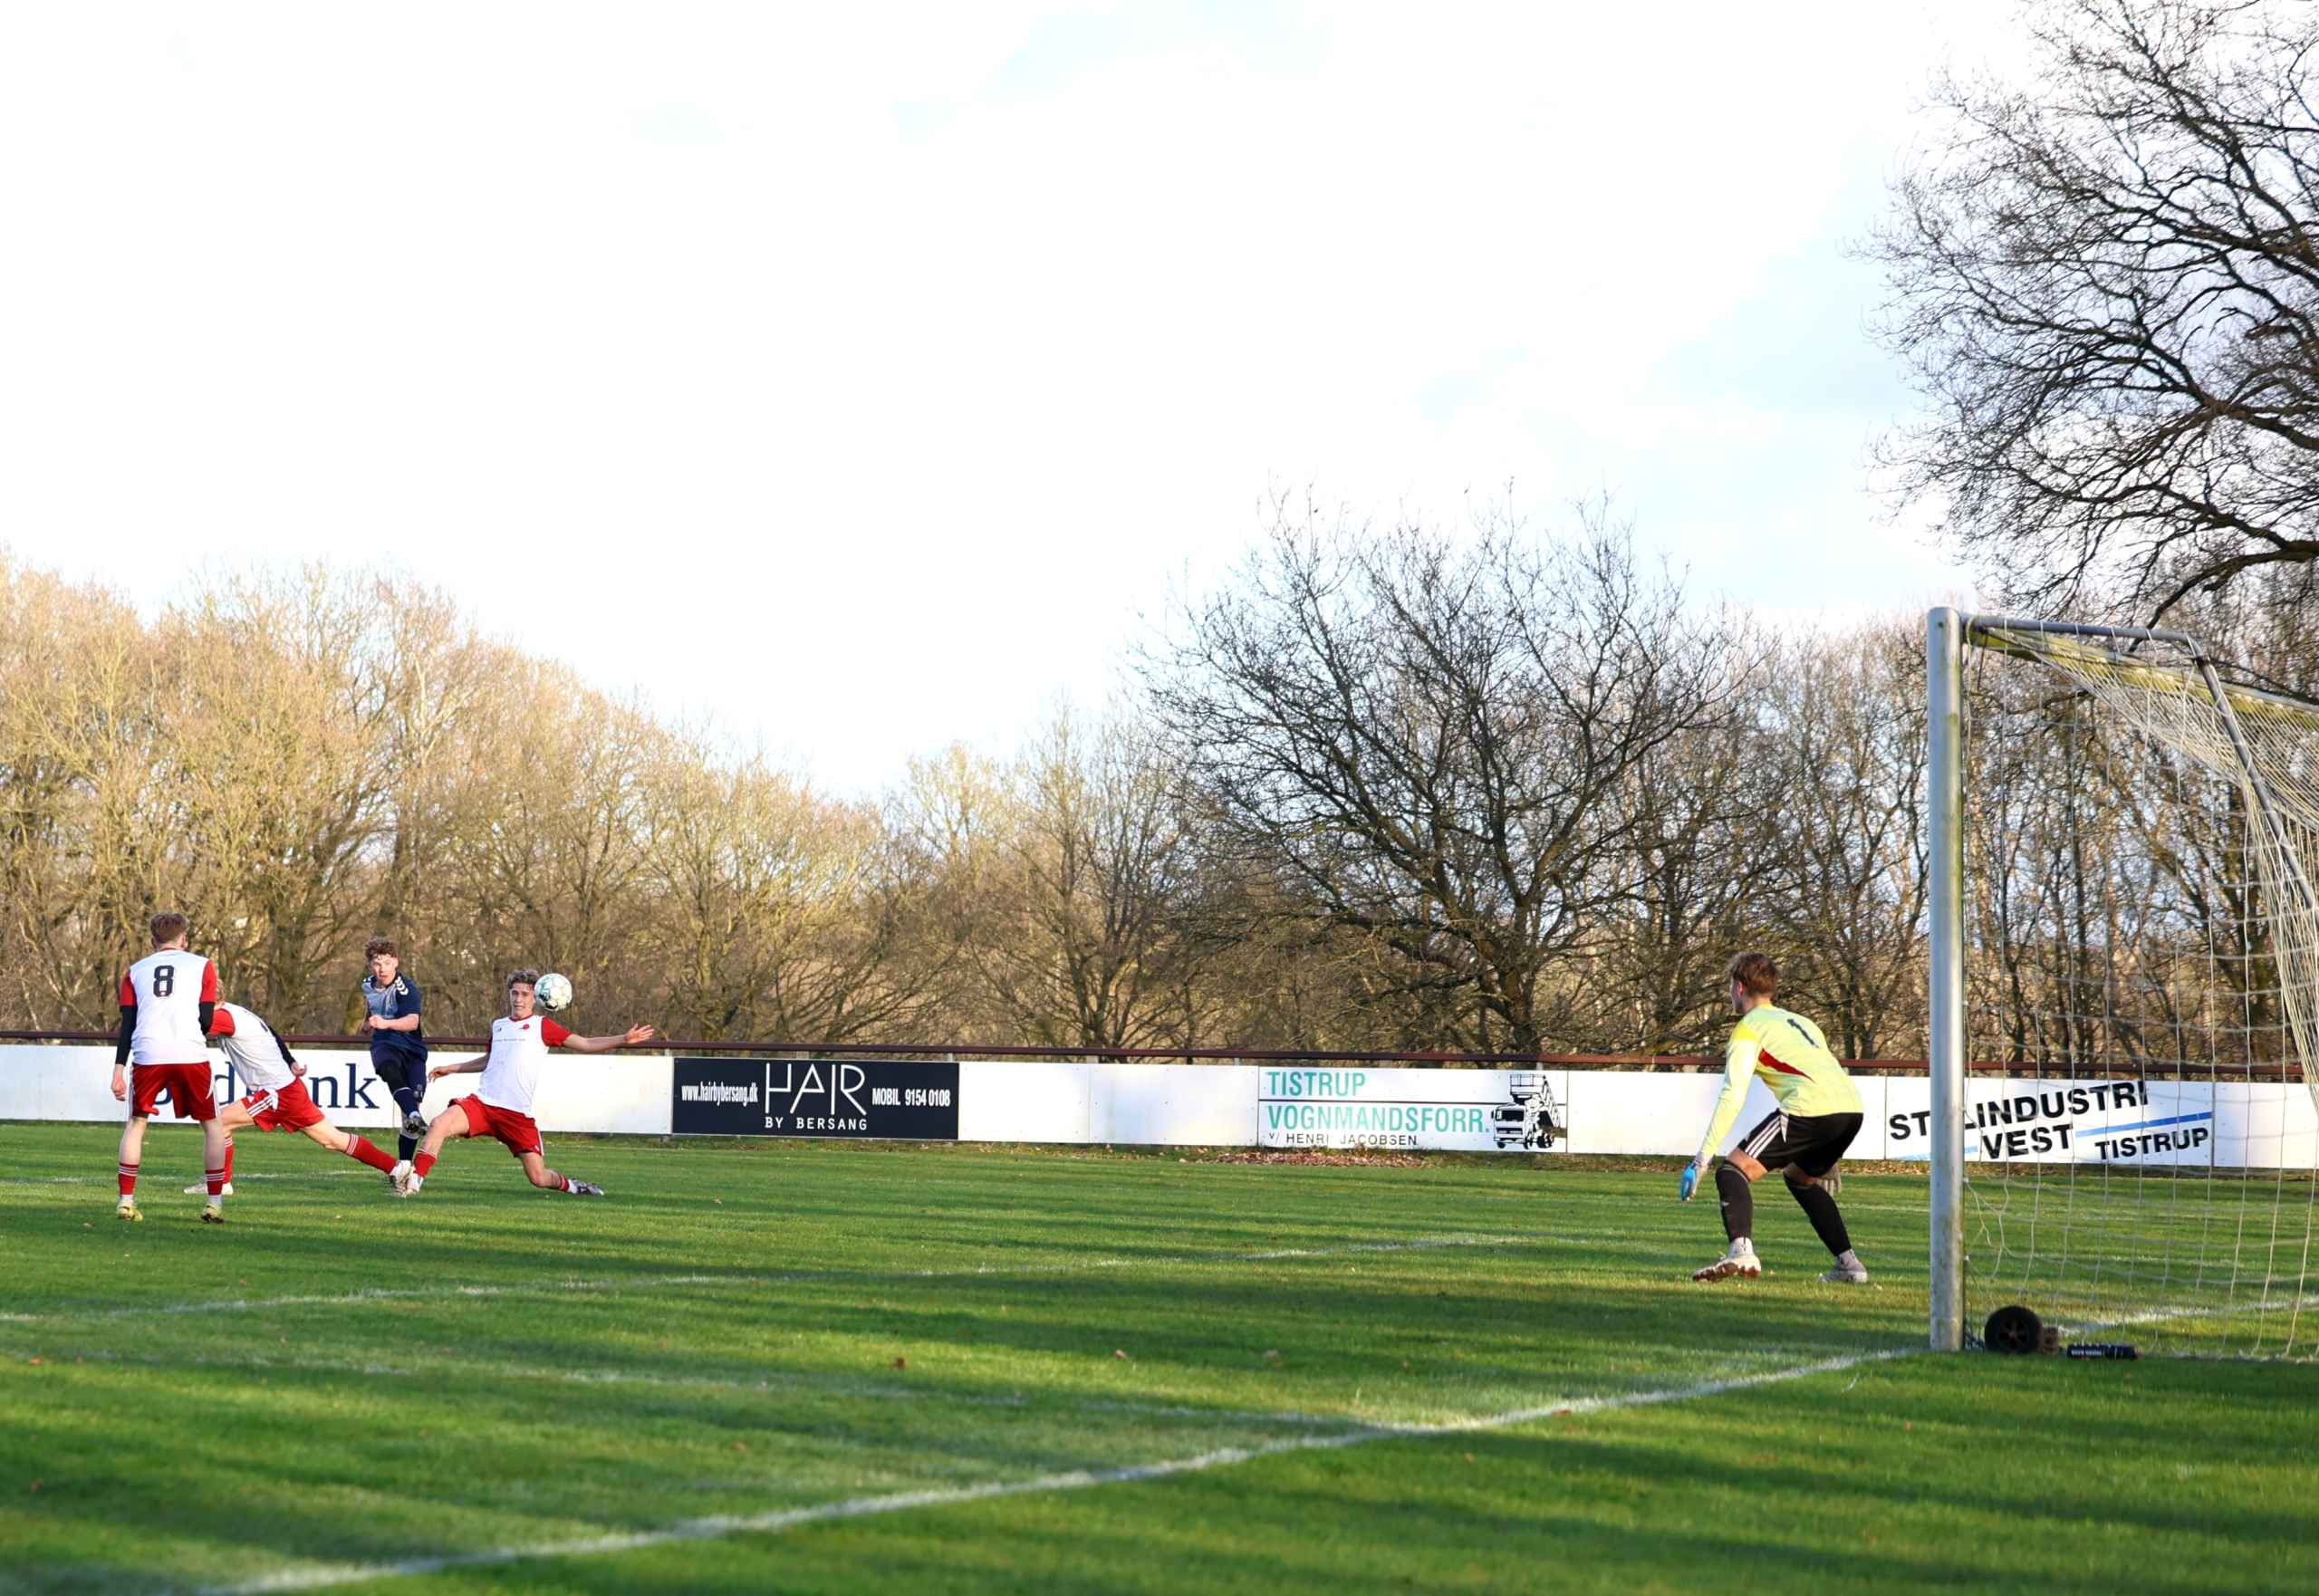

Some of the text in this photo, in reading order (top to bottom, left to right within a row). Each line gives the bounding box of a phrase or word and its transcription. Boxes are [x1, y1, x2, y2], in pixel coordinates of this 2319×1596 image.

[152, 965, 176, 998] 8
[1786, 1017, 1820, 1049] 1
[680, 1081, 758, 1107] www.hairbybersang.dk
[765, 1062, 867, 1115] HAIR
[871, 1088, 951, 1107] MOBIL 9154 0108
[1267, 1071, 1366, 1097] TISTRUP
[765, 1117, 868, 1130] BY BERSANG
[1267, 1104, 1490, 1133] VOGNMANDSFORR.
[1286, 1133, 1329, 1144] HENRI
[1340, 1134, 1418, 1146] JACOBSEN
[1982, 1123, 2074, 1159] VEST
[2094, 1127, 2209, 1160] TISTRUP
